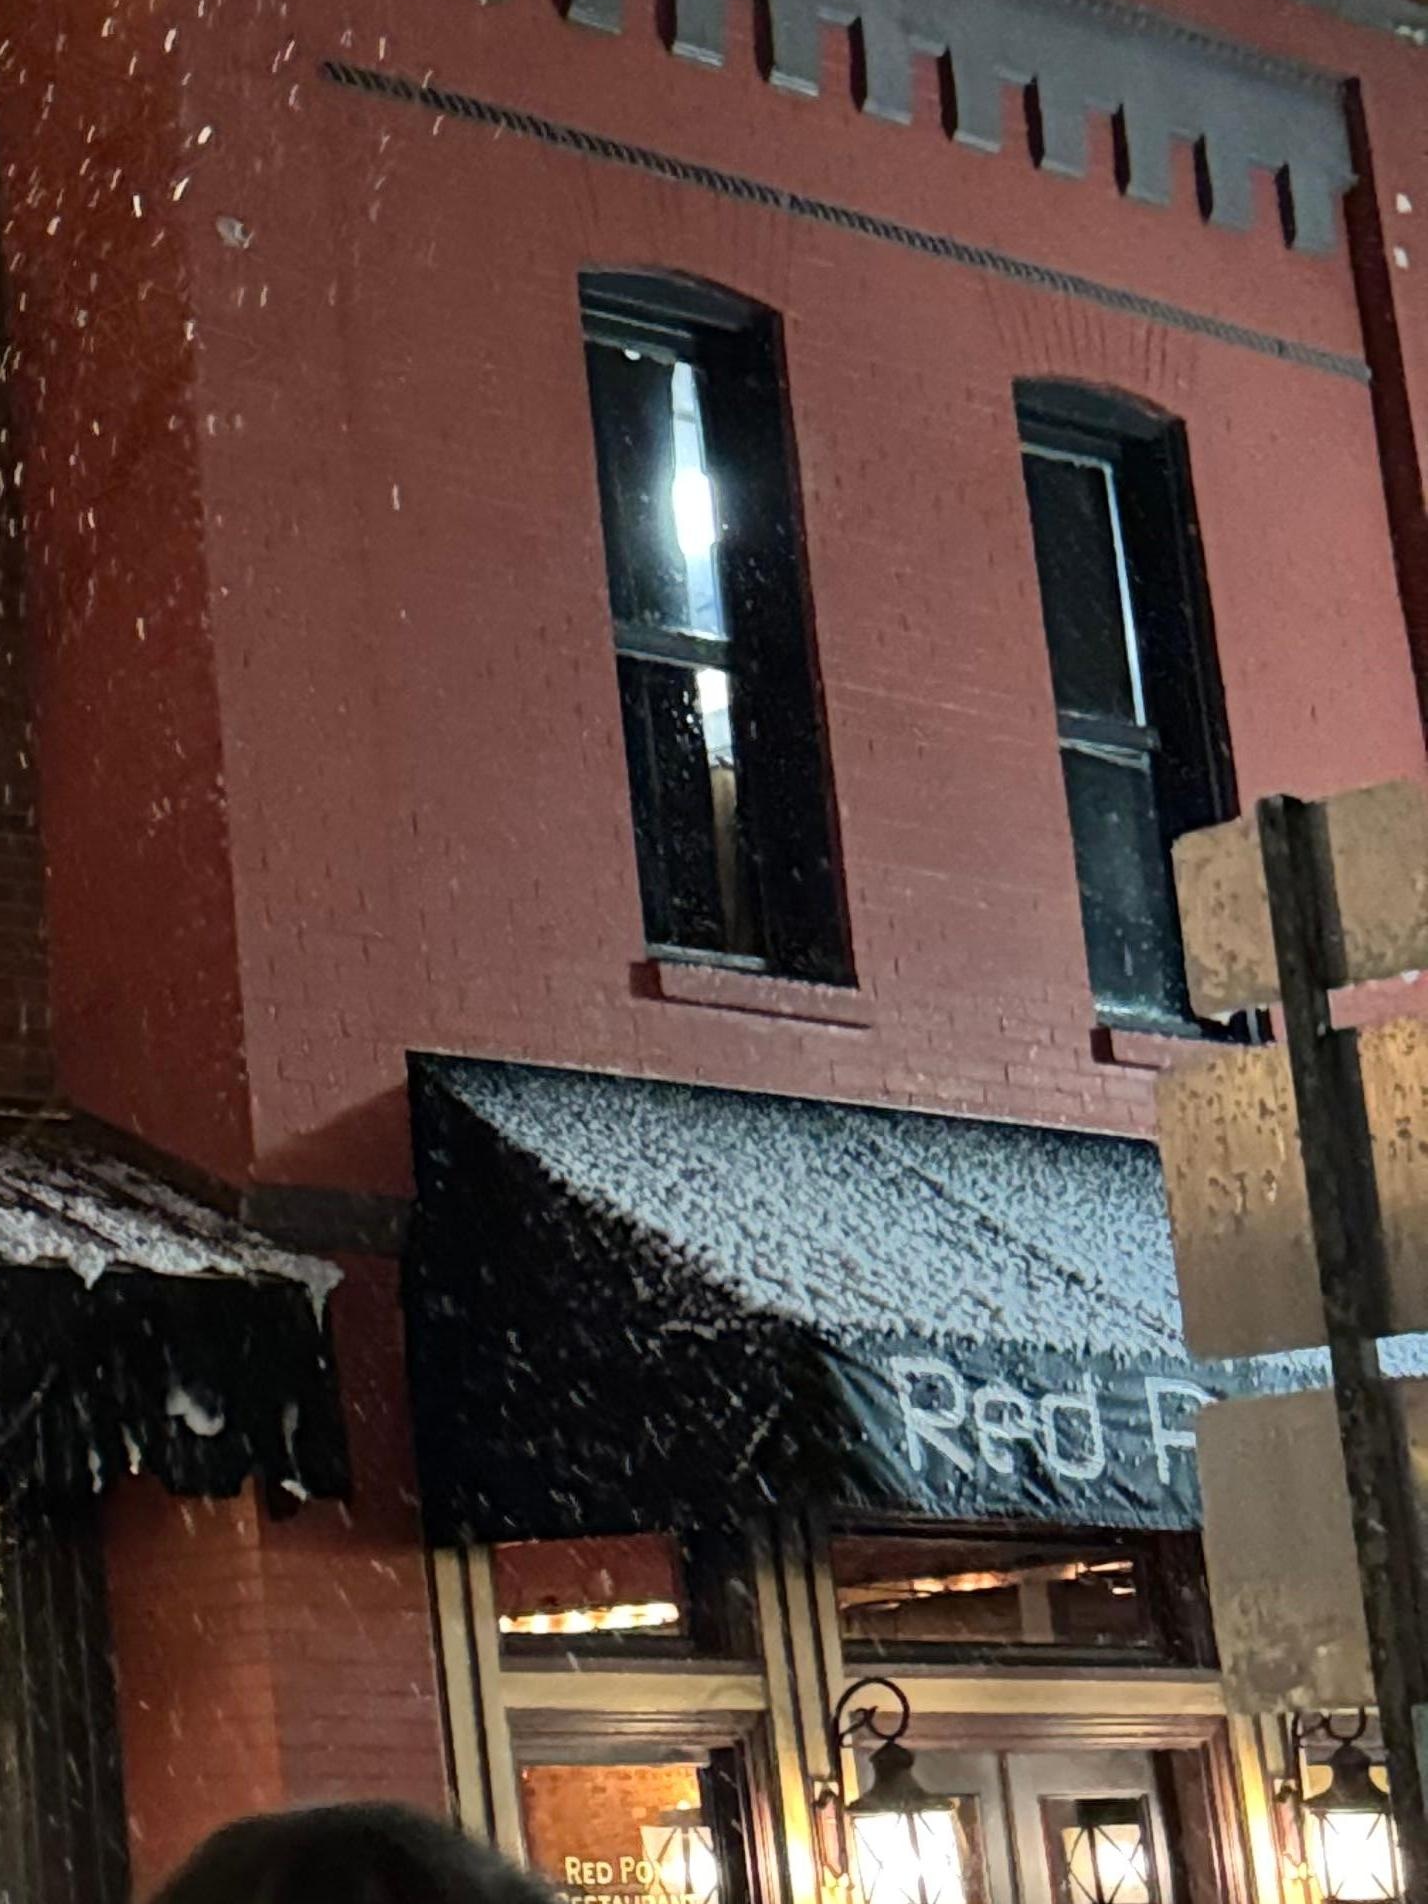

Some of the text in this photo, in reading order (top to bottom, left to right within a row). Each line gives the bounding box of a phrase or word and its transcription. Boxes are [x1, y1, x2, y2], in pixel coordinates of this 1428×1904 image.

[888, 1356, 1107, 1482] Red
[565, 1855, 664, 1886] RED PO
